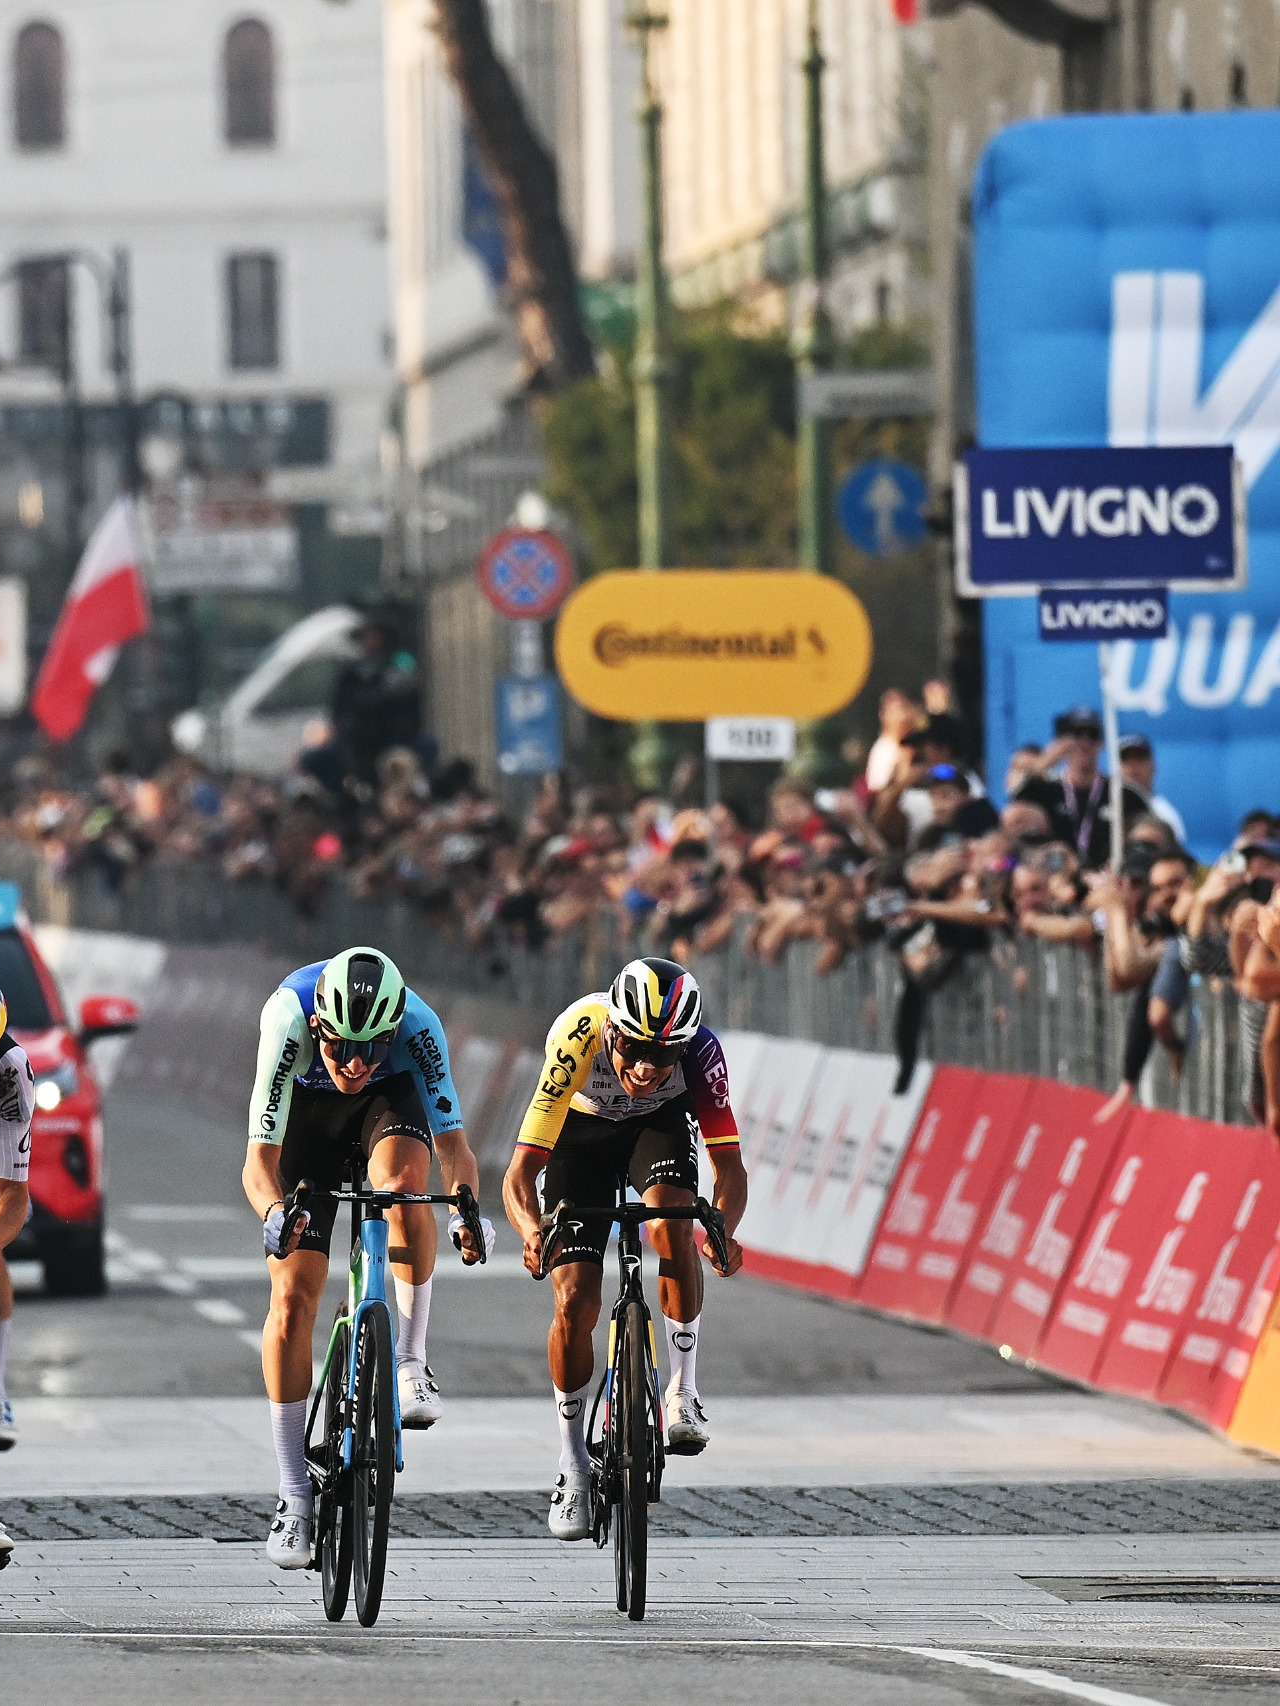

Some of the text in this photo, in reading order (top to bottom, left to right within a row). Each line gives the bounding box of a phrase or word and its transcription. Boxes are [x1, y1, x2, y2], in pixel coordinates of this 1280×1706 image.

[982, 485, 1220, 538] LIVIGNO
[1041, 599, 1164, 629] LIVIGNO
[592, 622, 798, 669] Continental
[406, 1036, 439, 1096] MONDIALE
[417, 1028, 443, 1063] AG2R
[266, 1038, 300, 1112] DECATHLON
[533, 1047, 577, 1113] INEOS
[697, 1038, 730, 1109] INEOS
[304, 1229, 322, 1238] SEL
